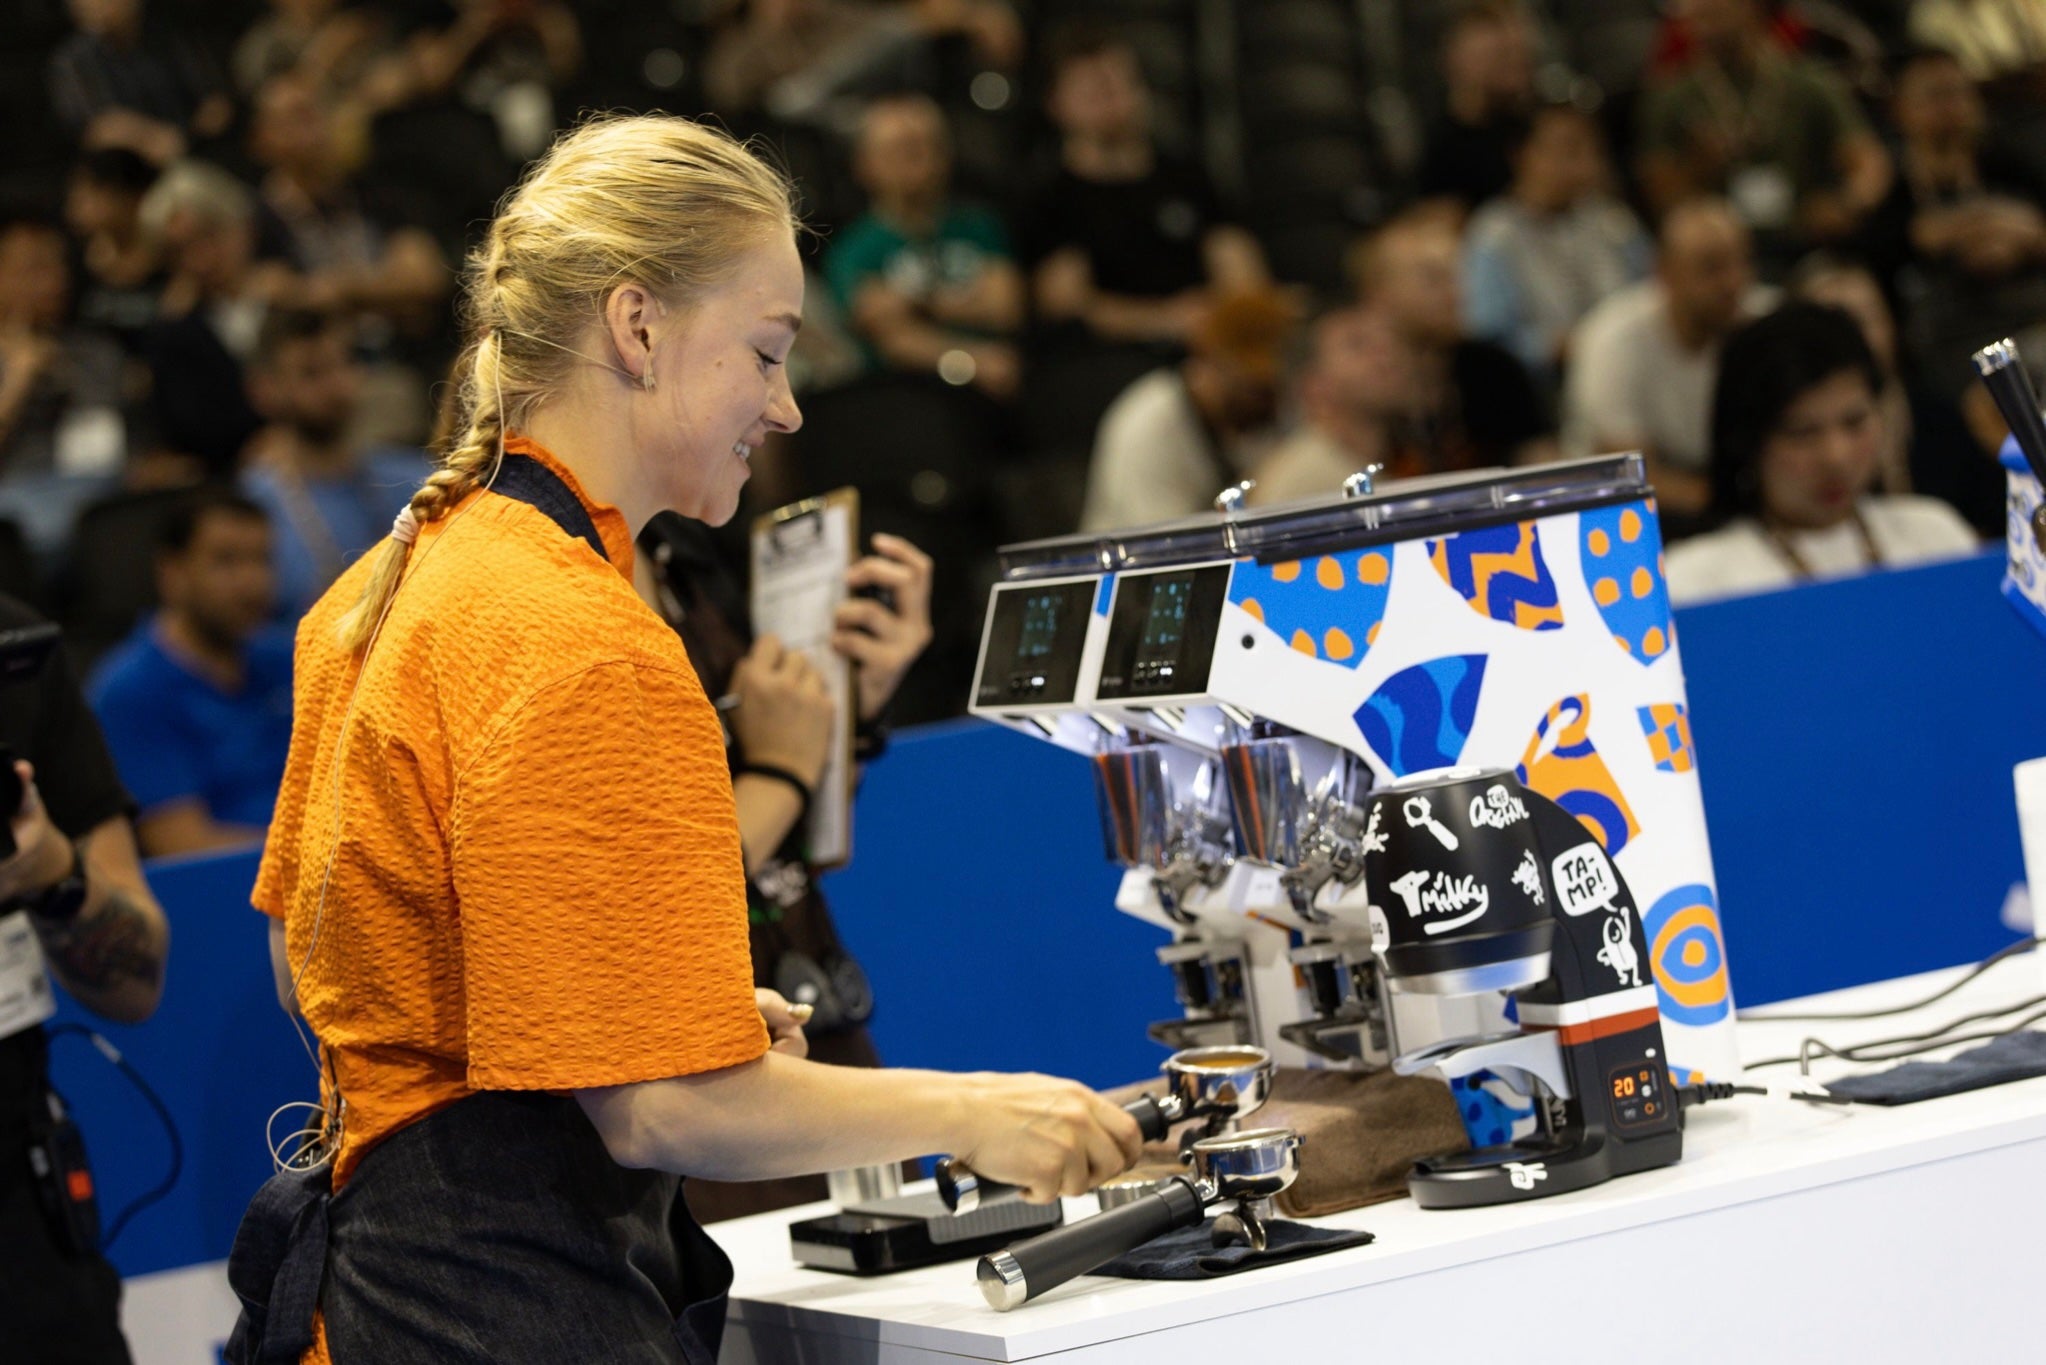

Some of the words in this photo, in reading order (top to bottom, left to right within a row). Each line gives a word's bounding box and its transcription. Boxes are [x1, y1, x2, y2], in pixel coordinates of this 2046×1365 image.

[1562, 855, 1595, 882] TA-
[1567, 867, 1607, 907] MP!
[1613, 1076, 1635, 1098] 20
